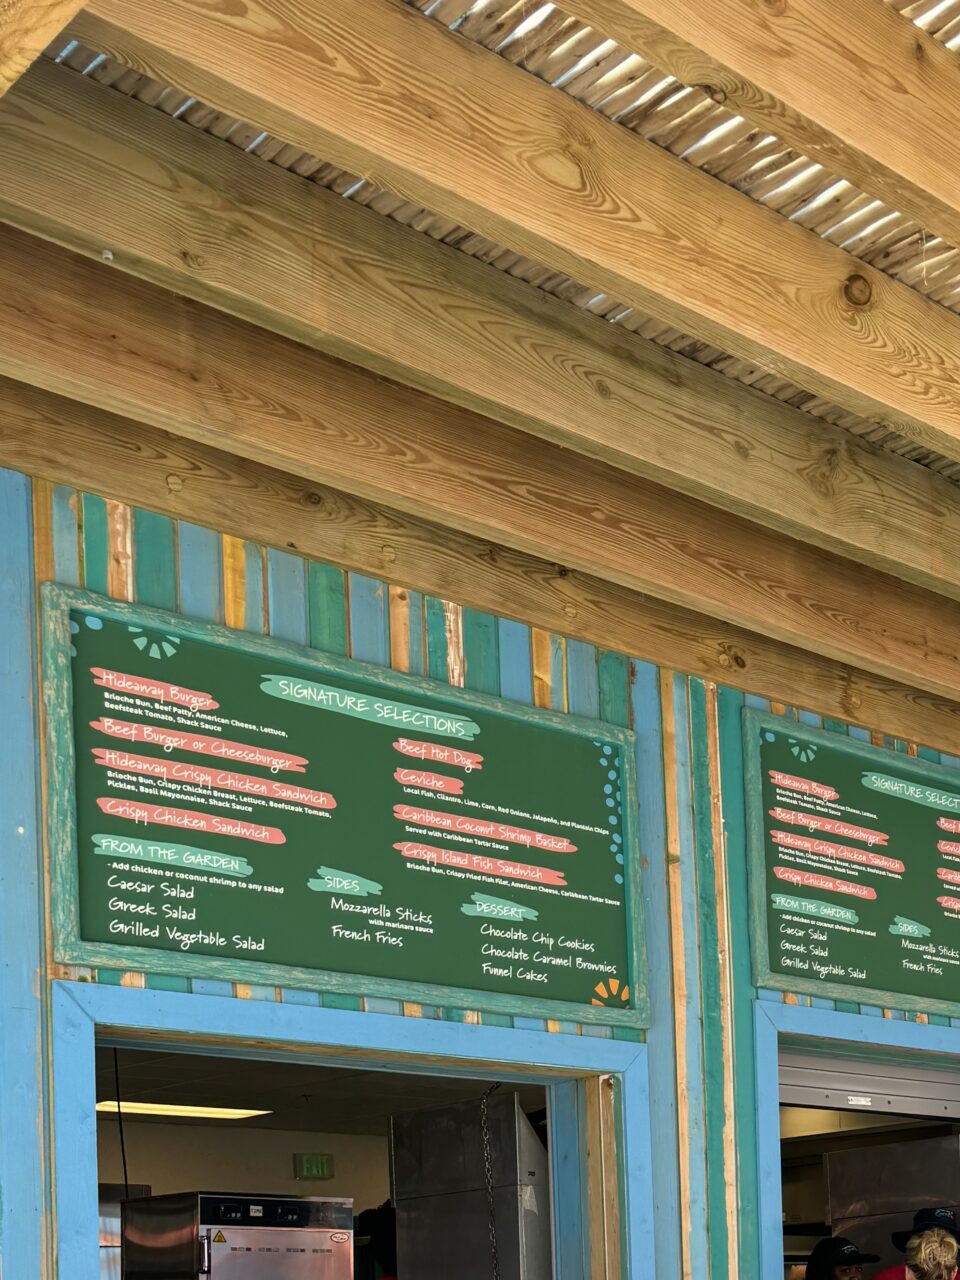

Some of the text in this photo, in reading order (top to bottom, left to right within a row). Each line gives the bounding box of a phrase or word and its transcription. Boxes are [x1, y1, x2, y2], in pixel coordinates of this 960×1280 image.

[102, 672, 213, 712] Hideaway Burger
[104, 692, 288, 738] Brioche Bun, Beef Patty, American Cheese, Lettuce,
[104, 701, 222, 732] Beefsteak Tomato, Shack Sauce
[279, 680, 465, 736] SIGNATURE SELECTIONS
[103, 719, 292, 774] Beef Burger or Cheeseburger
[400, 739, 473, 773] Beef Hot Dog
[105, 752, 327, 805] Hideaway Crispy Chicken Sandwich
[400, 770, 445, 789] Ceviche
[776, 774, 836, 801] Hideaway Burger
[871, 775, 923, 799] SIGNATURE
[107, 770, 332, 818] Brioche Bun, Crispy Chicken Breast, Lettuce, Beefsteak Tomato,
[107, 780, 252, 812] Pickles, Basil Mayonnaise, Shack Sauce
[106, 800, 269, 840] Crispy Chicken Sandwich
[402, 807, 571, 850] Caribbean Coconut Shrimp Basket
[776, 808, 796, 824] Beef
[798, 812, 822, 832] Burger
[405, 826, 427, 837] Served
[443, 832, 473, 844] Caribbean
[474, 837, 491, 847] Tartar
[492, 841, 509, 850] Sauce
[101, 839, 239, 870] FROM THE GARDEN
[402, 843, 543, 879] Crispy Island Fish Sandwich
[107, 875, 194, 899] Caesar Salad
[112, 862, 130, 871] Add
[131, 865, 163, 877] chicken
[175, 872, 208, 883] coconut
[209, 876, 237, 888] shrimp
[248, 883, 262, 893] any
[263, 885, 284, 894] salad
[324, 876, 360, 892] SIDES
[779, 868, 867, 896] Crispy Chicken Sandwich
[108, 897, 196, 921] Greek Salad
[331, 897, 433, 925] Mozzarella Sticks
[476, 902, 526, 919] DESSERT
[776, 897, 852, 919] FROM THE GARDEN
[110, 920, 265, 951] Grilled Vegetable Salad
[331, 925, 403, 947] French Fries
[369, 918, 384, 927] with
[386, 921, 415, 930] marinara
[780, 924, 827, 940] Caesar Salad
[898, 923, 918, 934] SIDES
[481, 924, 595, 952] Chocolate Chip Cookies
[781, 940, 828, 956] Greek Salad
[902, 938, 959, 958] Mozzarella Sticks
[481, 944, 617, 974] Chocolate Caramel Brownies
[782, 956, 866, 979] Grilled Vegetable Salad
[903, 959, 925, 971] French
[927, 964, 943, 975] Fries
[482, 963, 548, 983] Funnel Cakes
